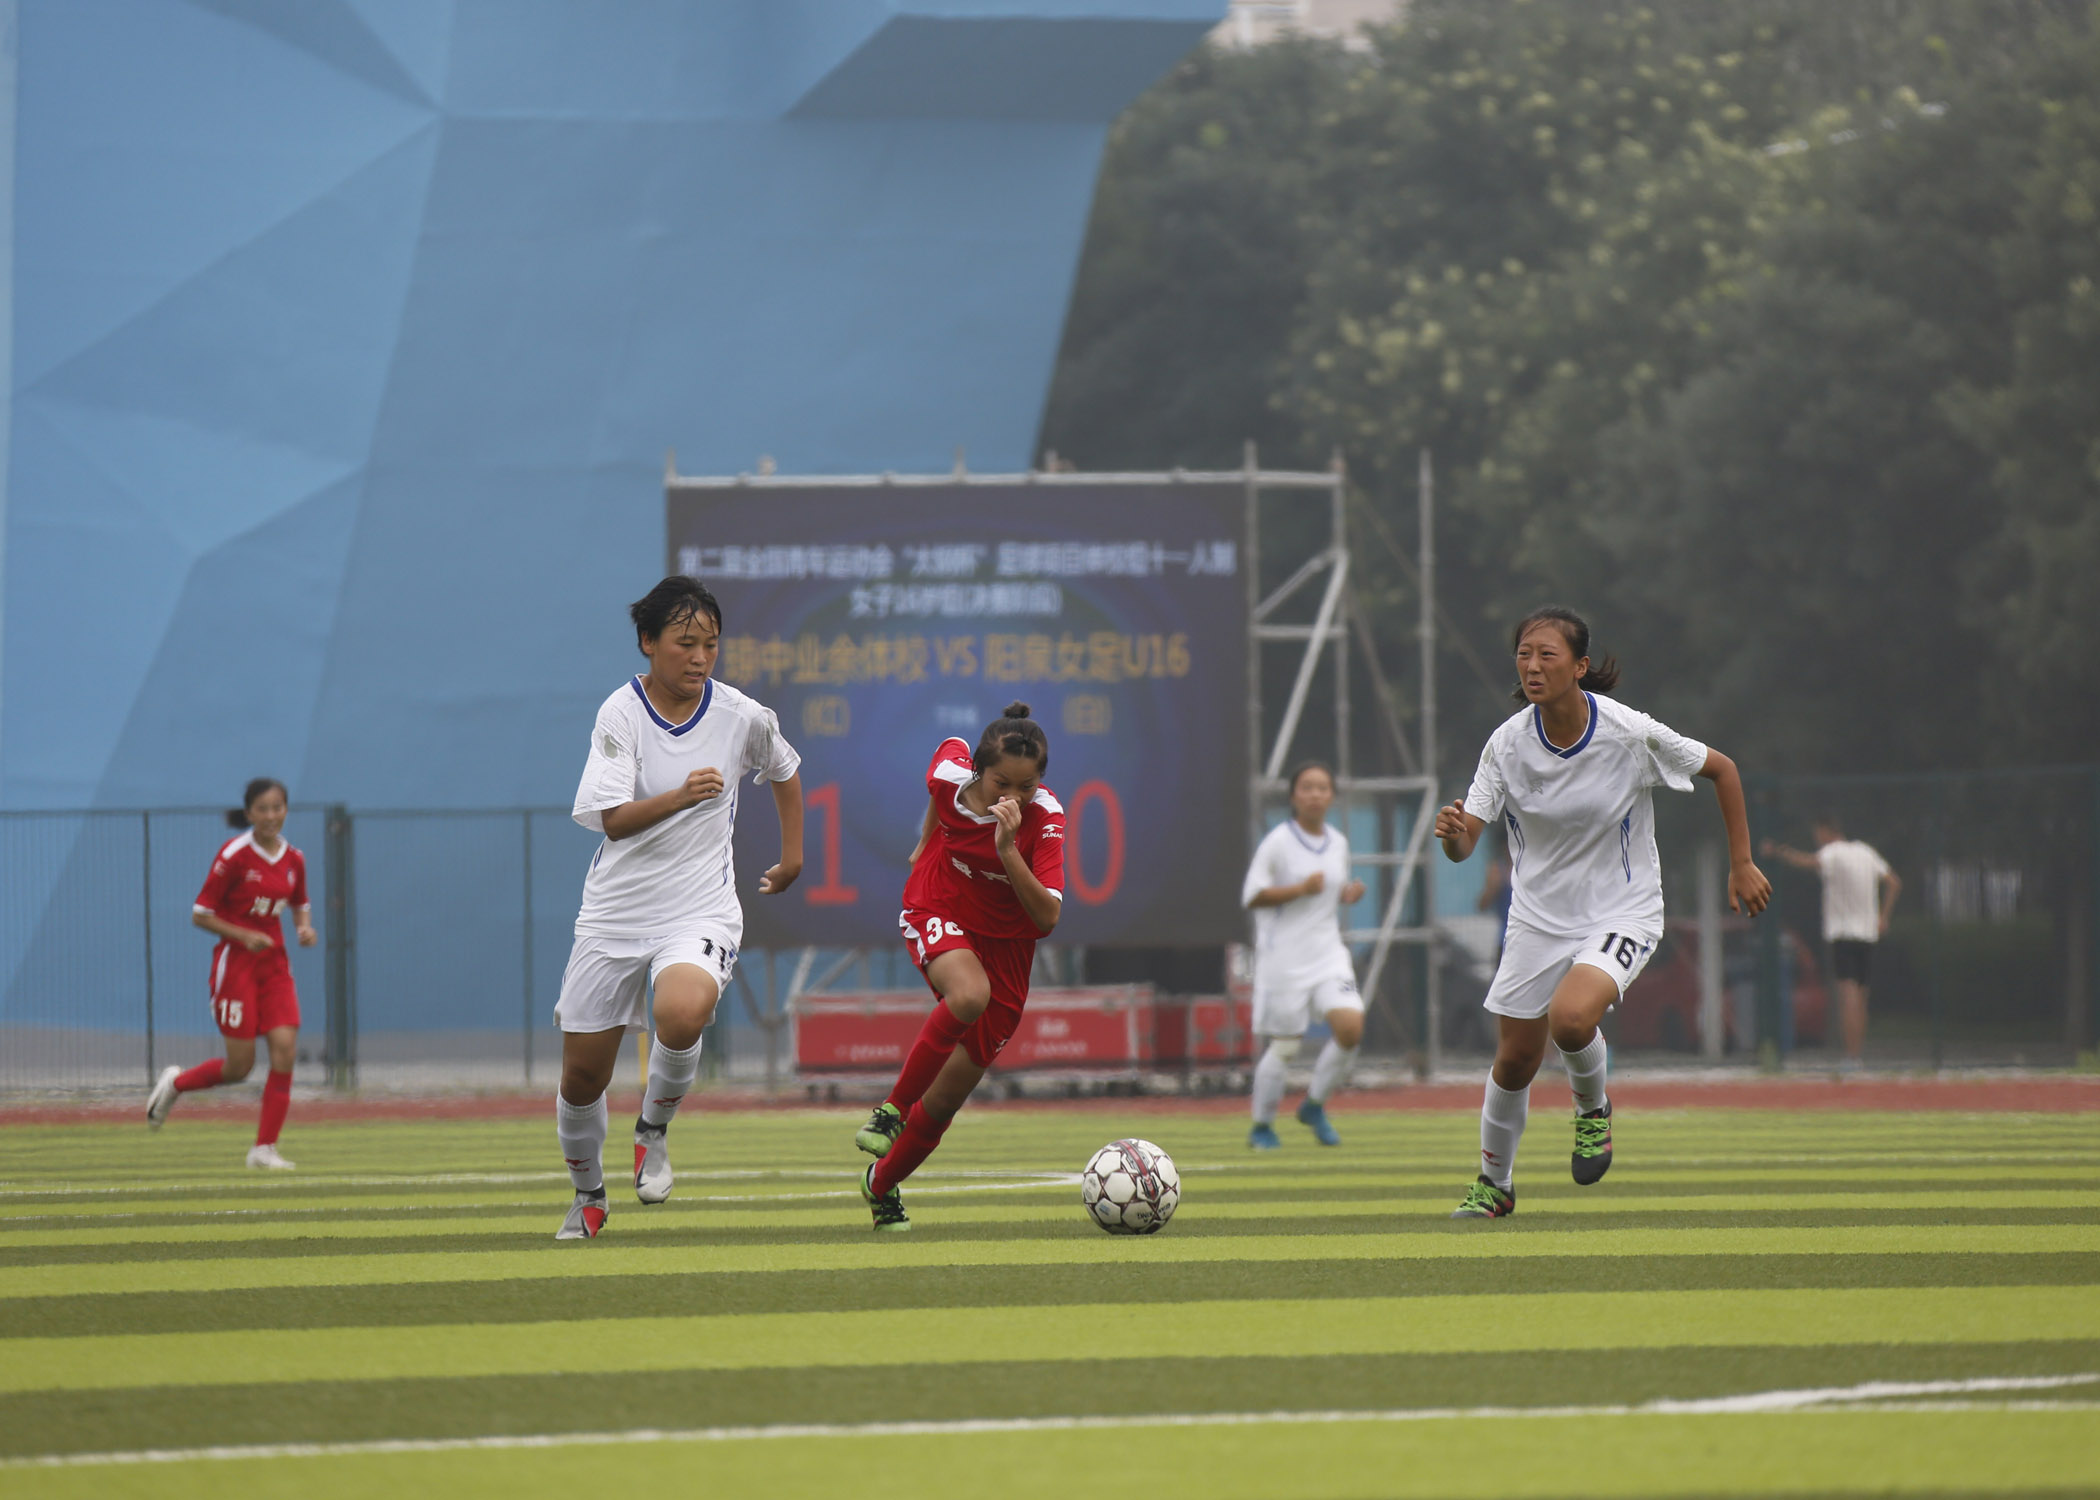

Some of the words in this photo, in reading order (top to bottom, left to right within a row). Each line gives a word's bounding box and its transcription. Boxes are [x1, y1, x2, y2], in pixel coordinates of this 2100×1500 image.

[931, 634, 979, 678] VS
[804, 781, 860, 905] 1
[1067, 779, 1126, 906] 0
[1600, 931, 1637, 970] 16
[219, 998, 244, 1028] 15
